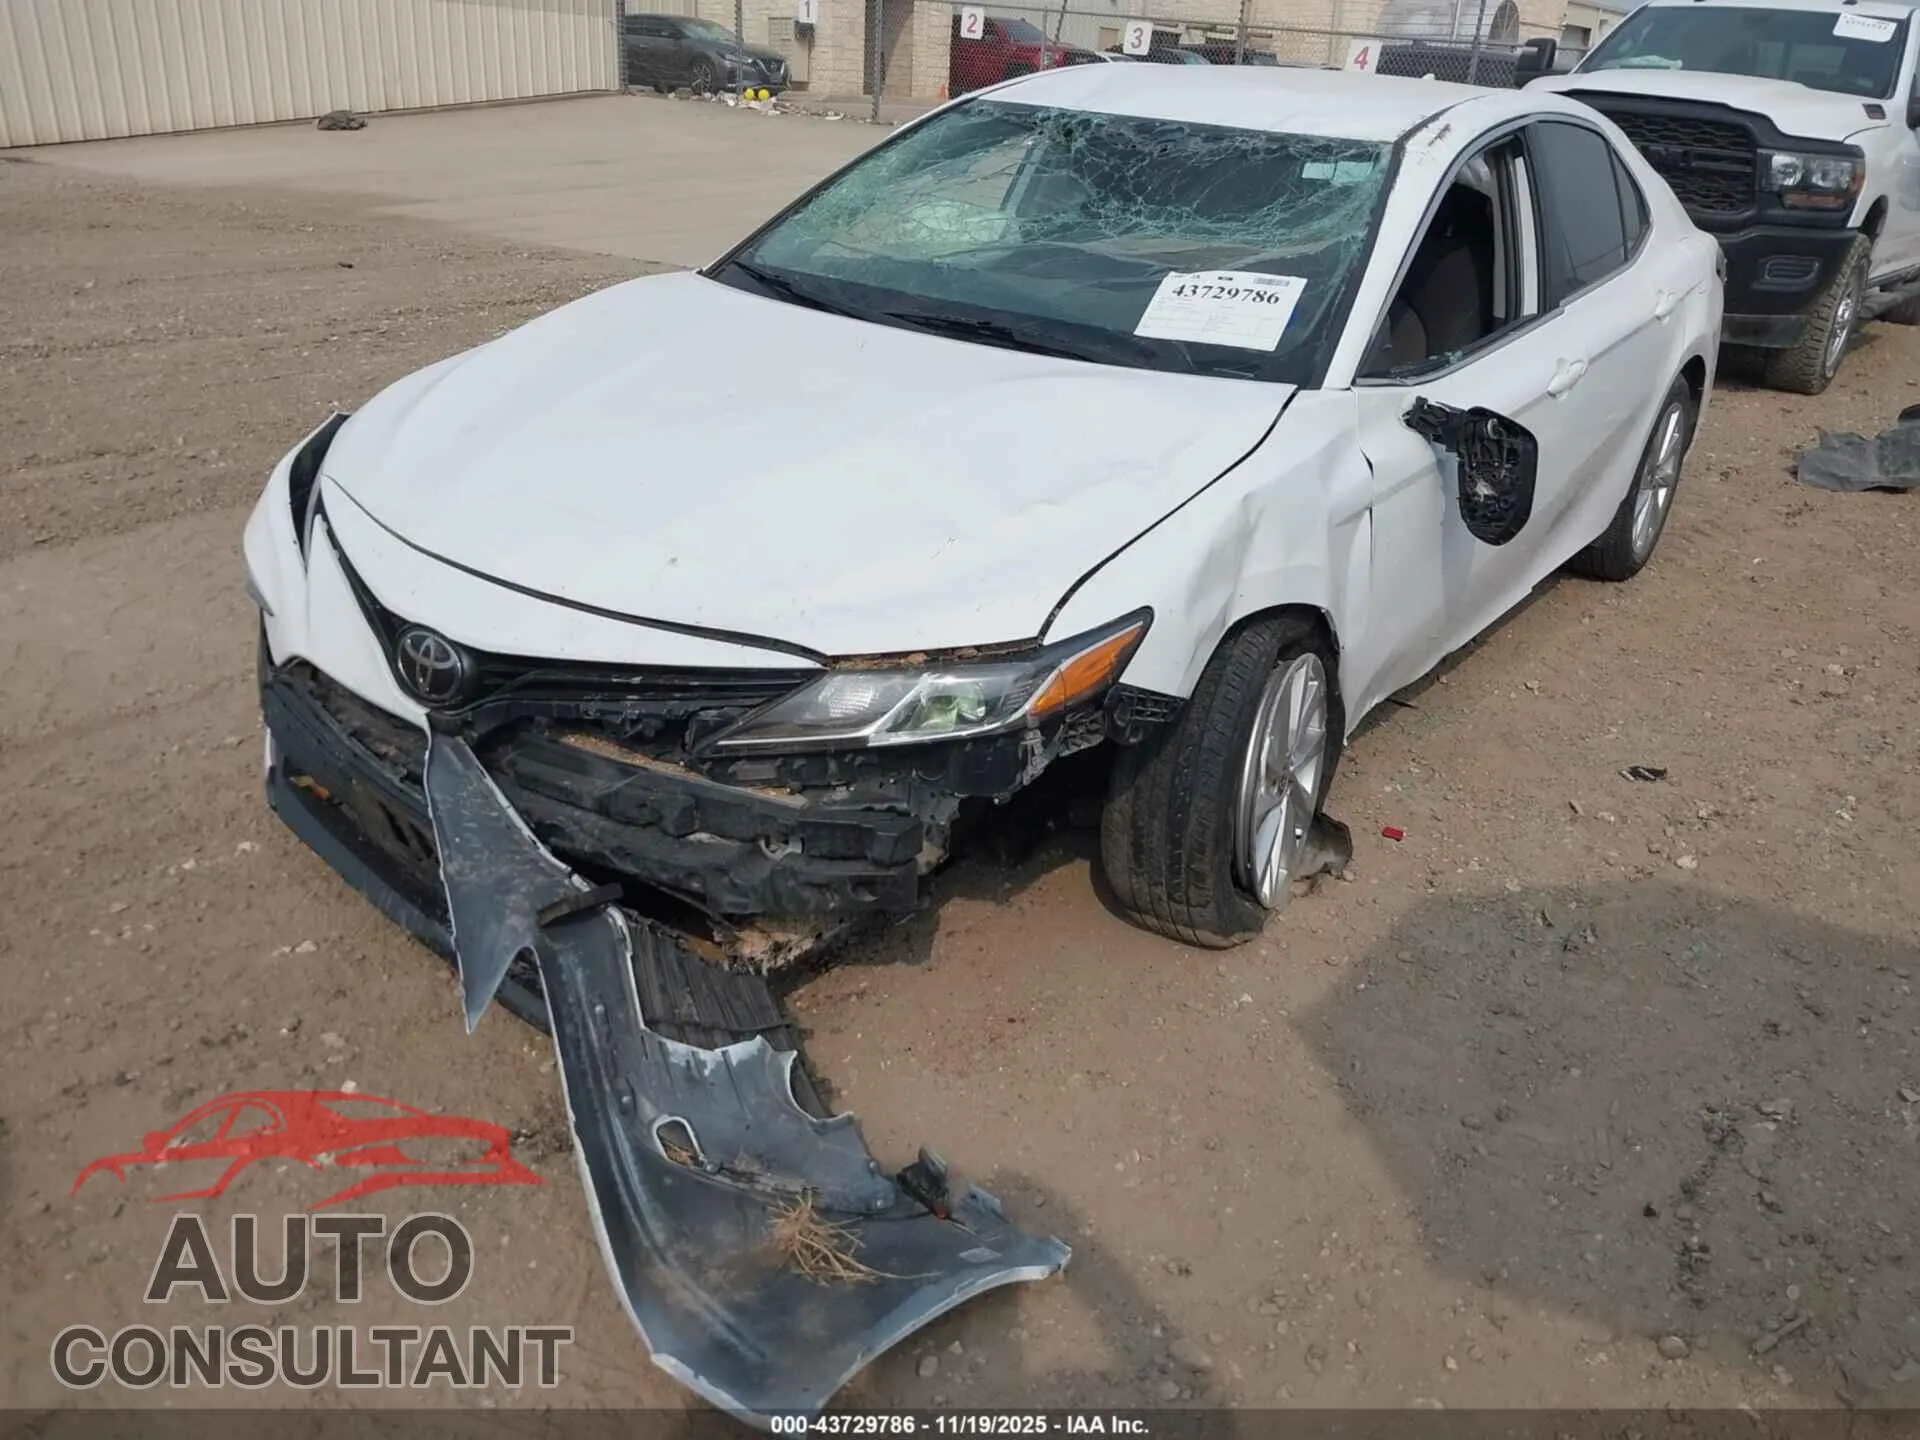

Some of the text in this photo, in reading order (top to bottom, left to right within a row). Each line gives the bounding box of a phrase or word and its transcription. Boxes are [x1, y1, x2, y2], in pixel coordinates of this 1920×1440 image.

[967, 13, 978, 33] 2
[1131, 27, 1144, 49] 3
[1353, 46, 1369, 70] 4
[1172, 284, 1280, 304] 43729786
